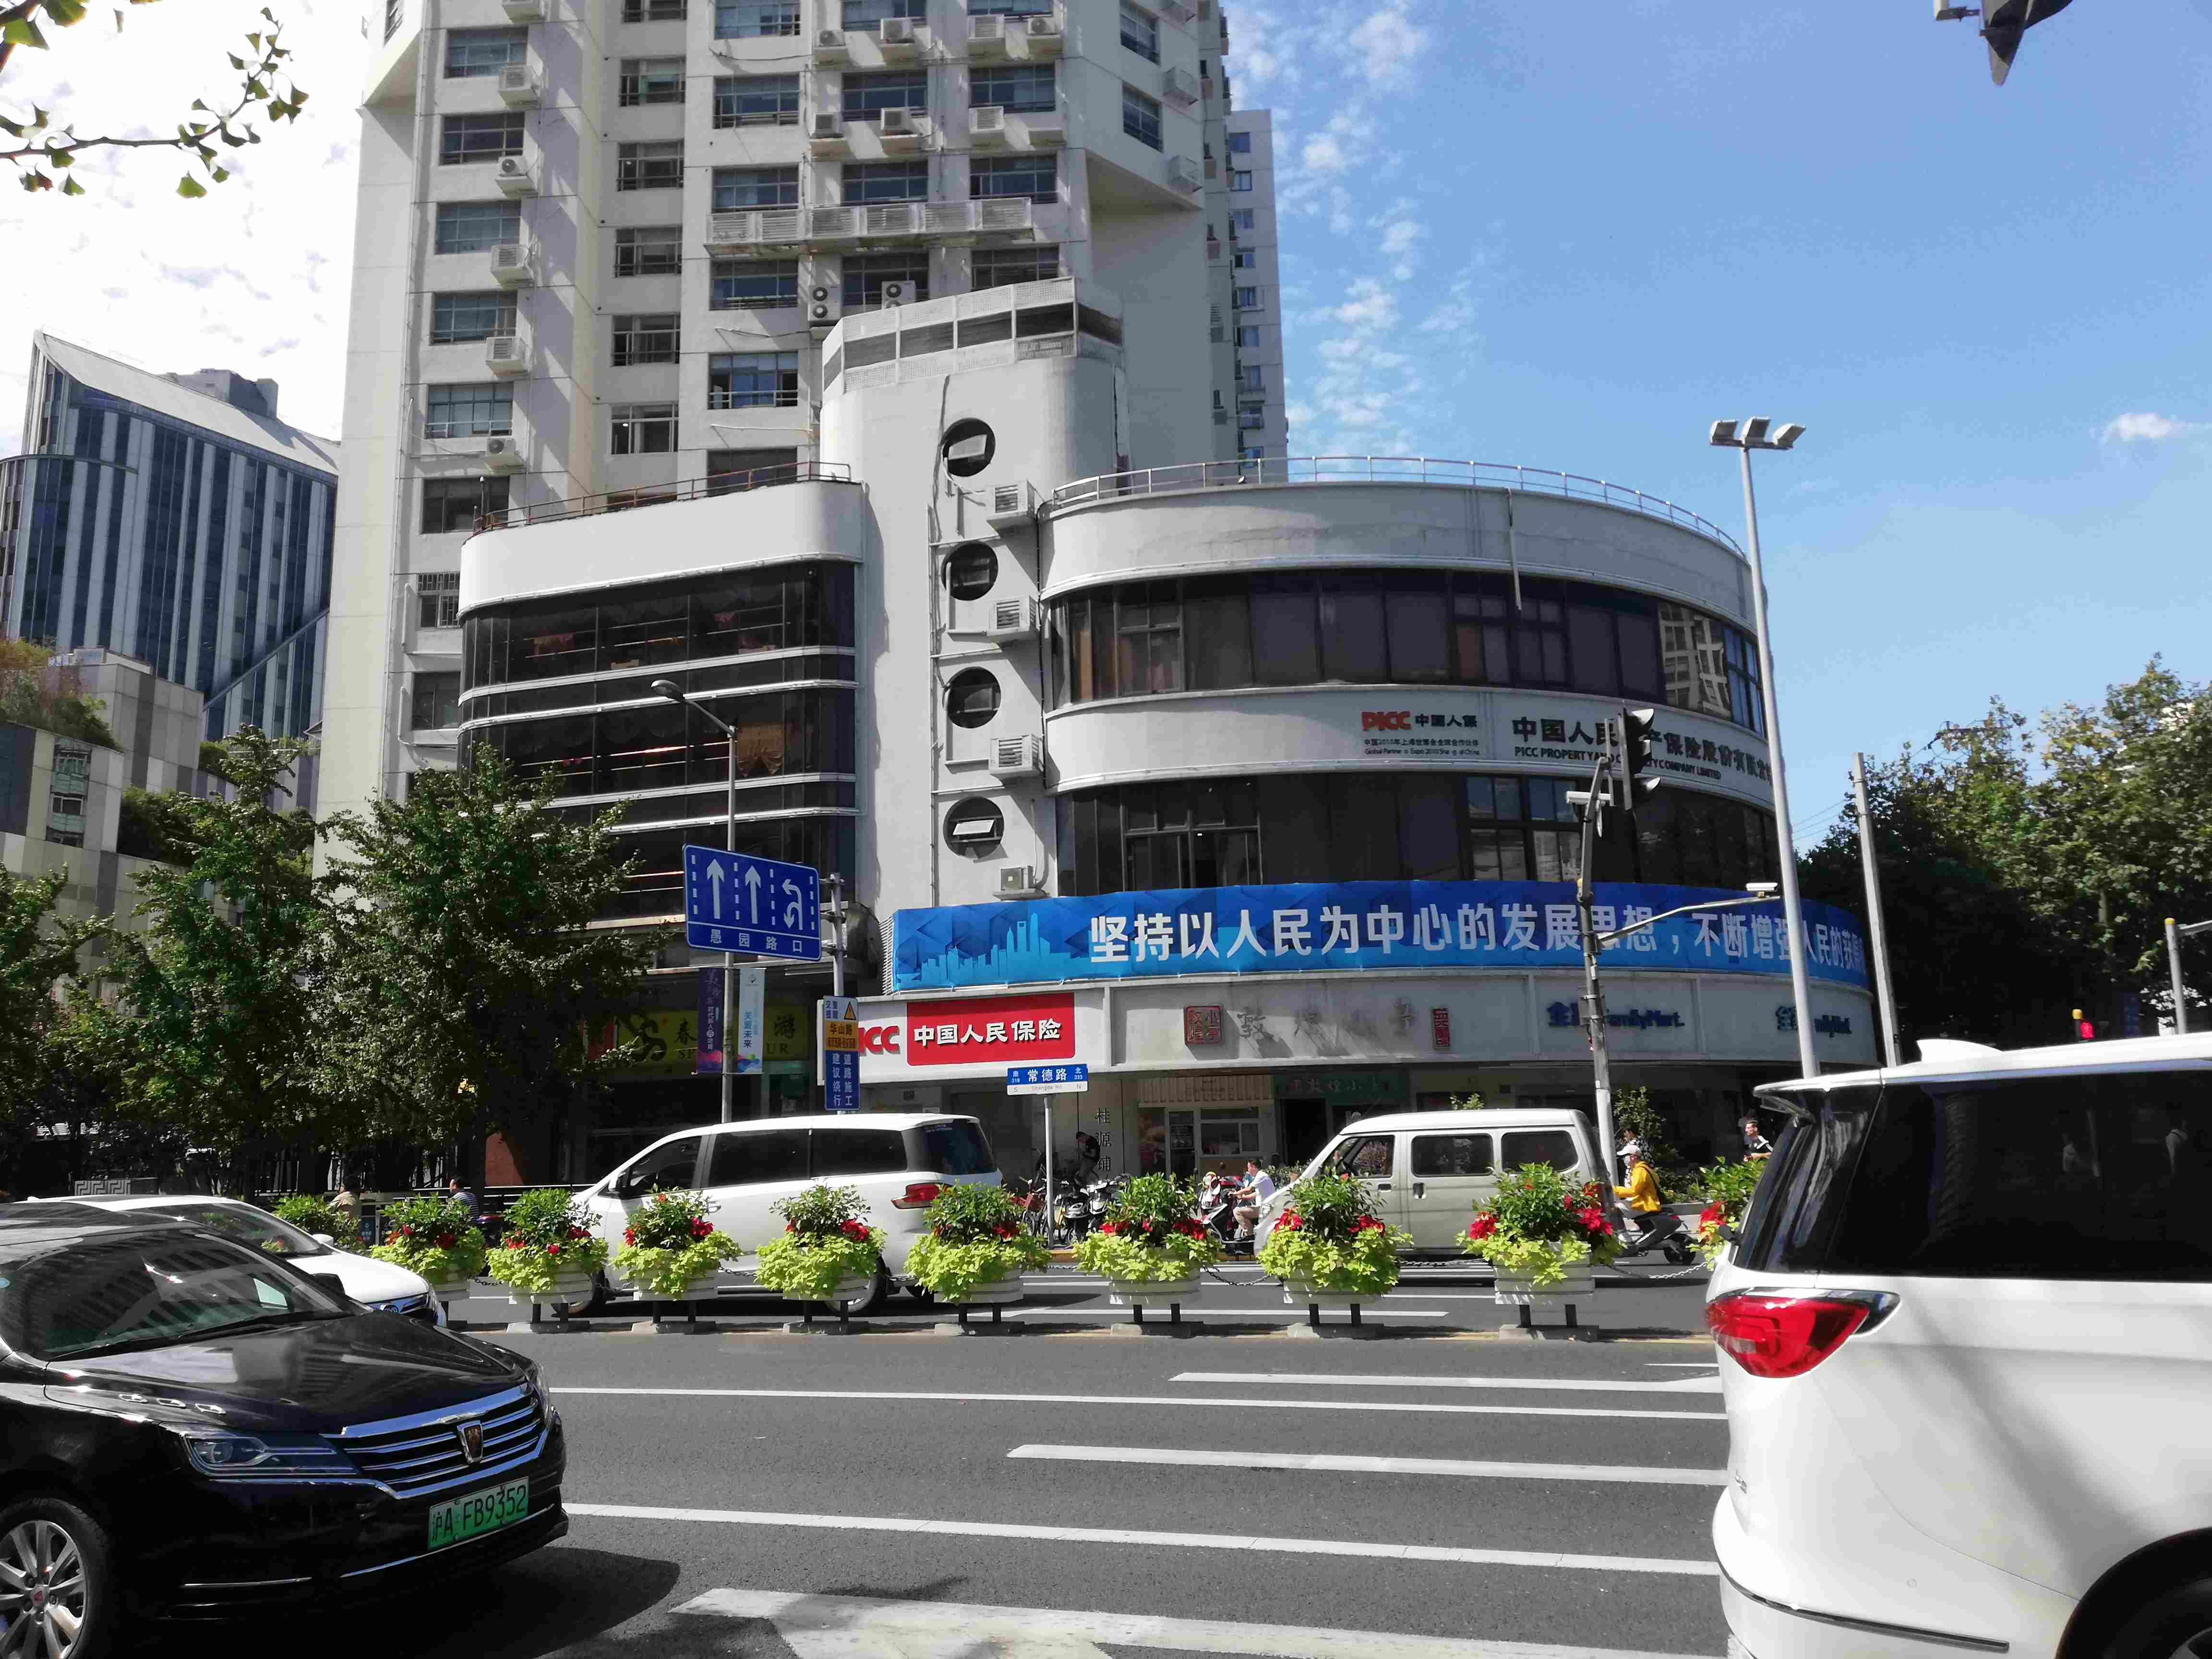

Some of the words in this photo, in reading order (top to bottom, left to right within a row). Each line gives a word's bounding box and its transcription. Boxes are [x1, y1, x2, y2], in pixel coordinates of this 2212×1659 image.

[1361, 711, 1411, 730] PICC
[1415, 714, 1478, 727] 中国人保
[1515, 746, 1538, 757] PICC
[710, 929, 802, 952] 愚园路口
[830, 1023, 852, 1035] 华山路
[858, 1025, 900, 1055] ICC
[914, 1018, 1061, 1046] 中国人民保险
[833, 1053, 841, 1106] 建议绕行
[844, 1054, 853, 1106] 道路施工
[1028, 1068, 1067, 1082] 常德路
[463, 1485, 526, 1531] FB9352
